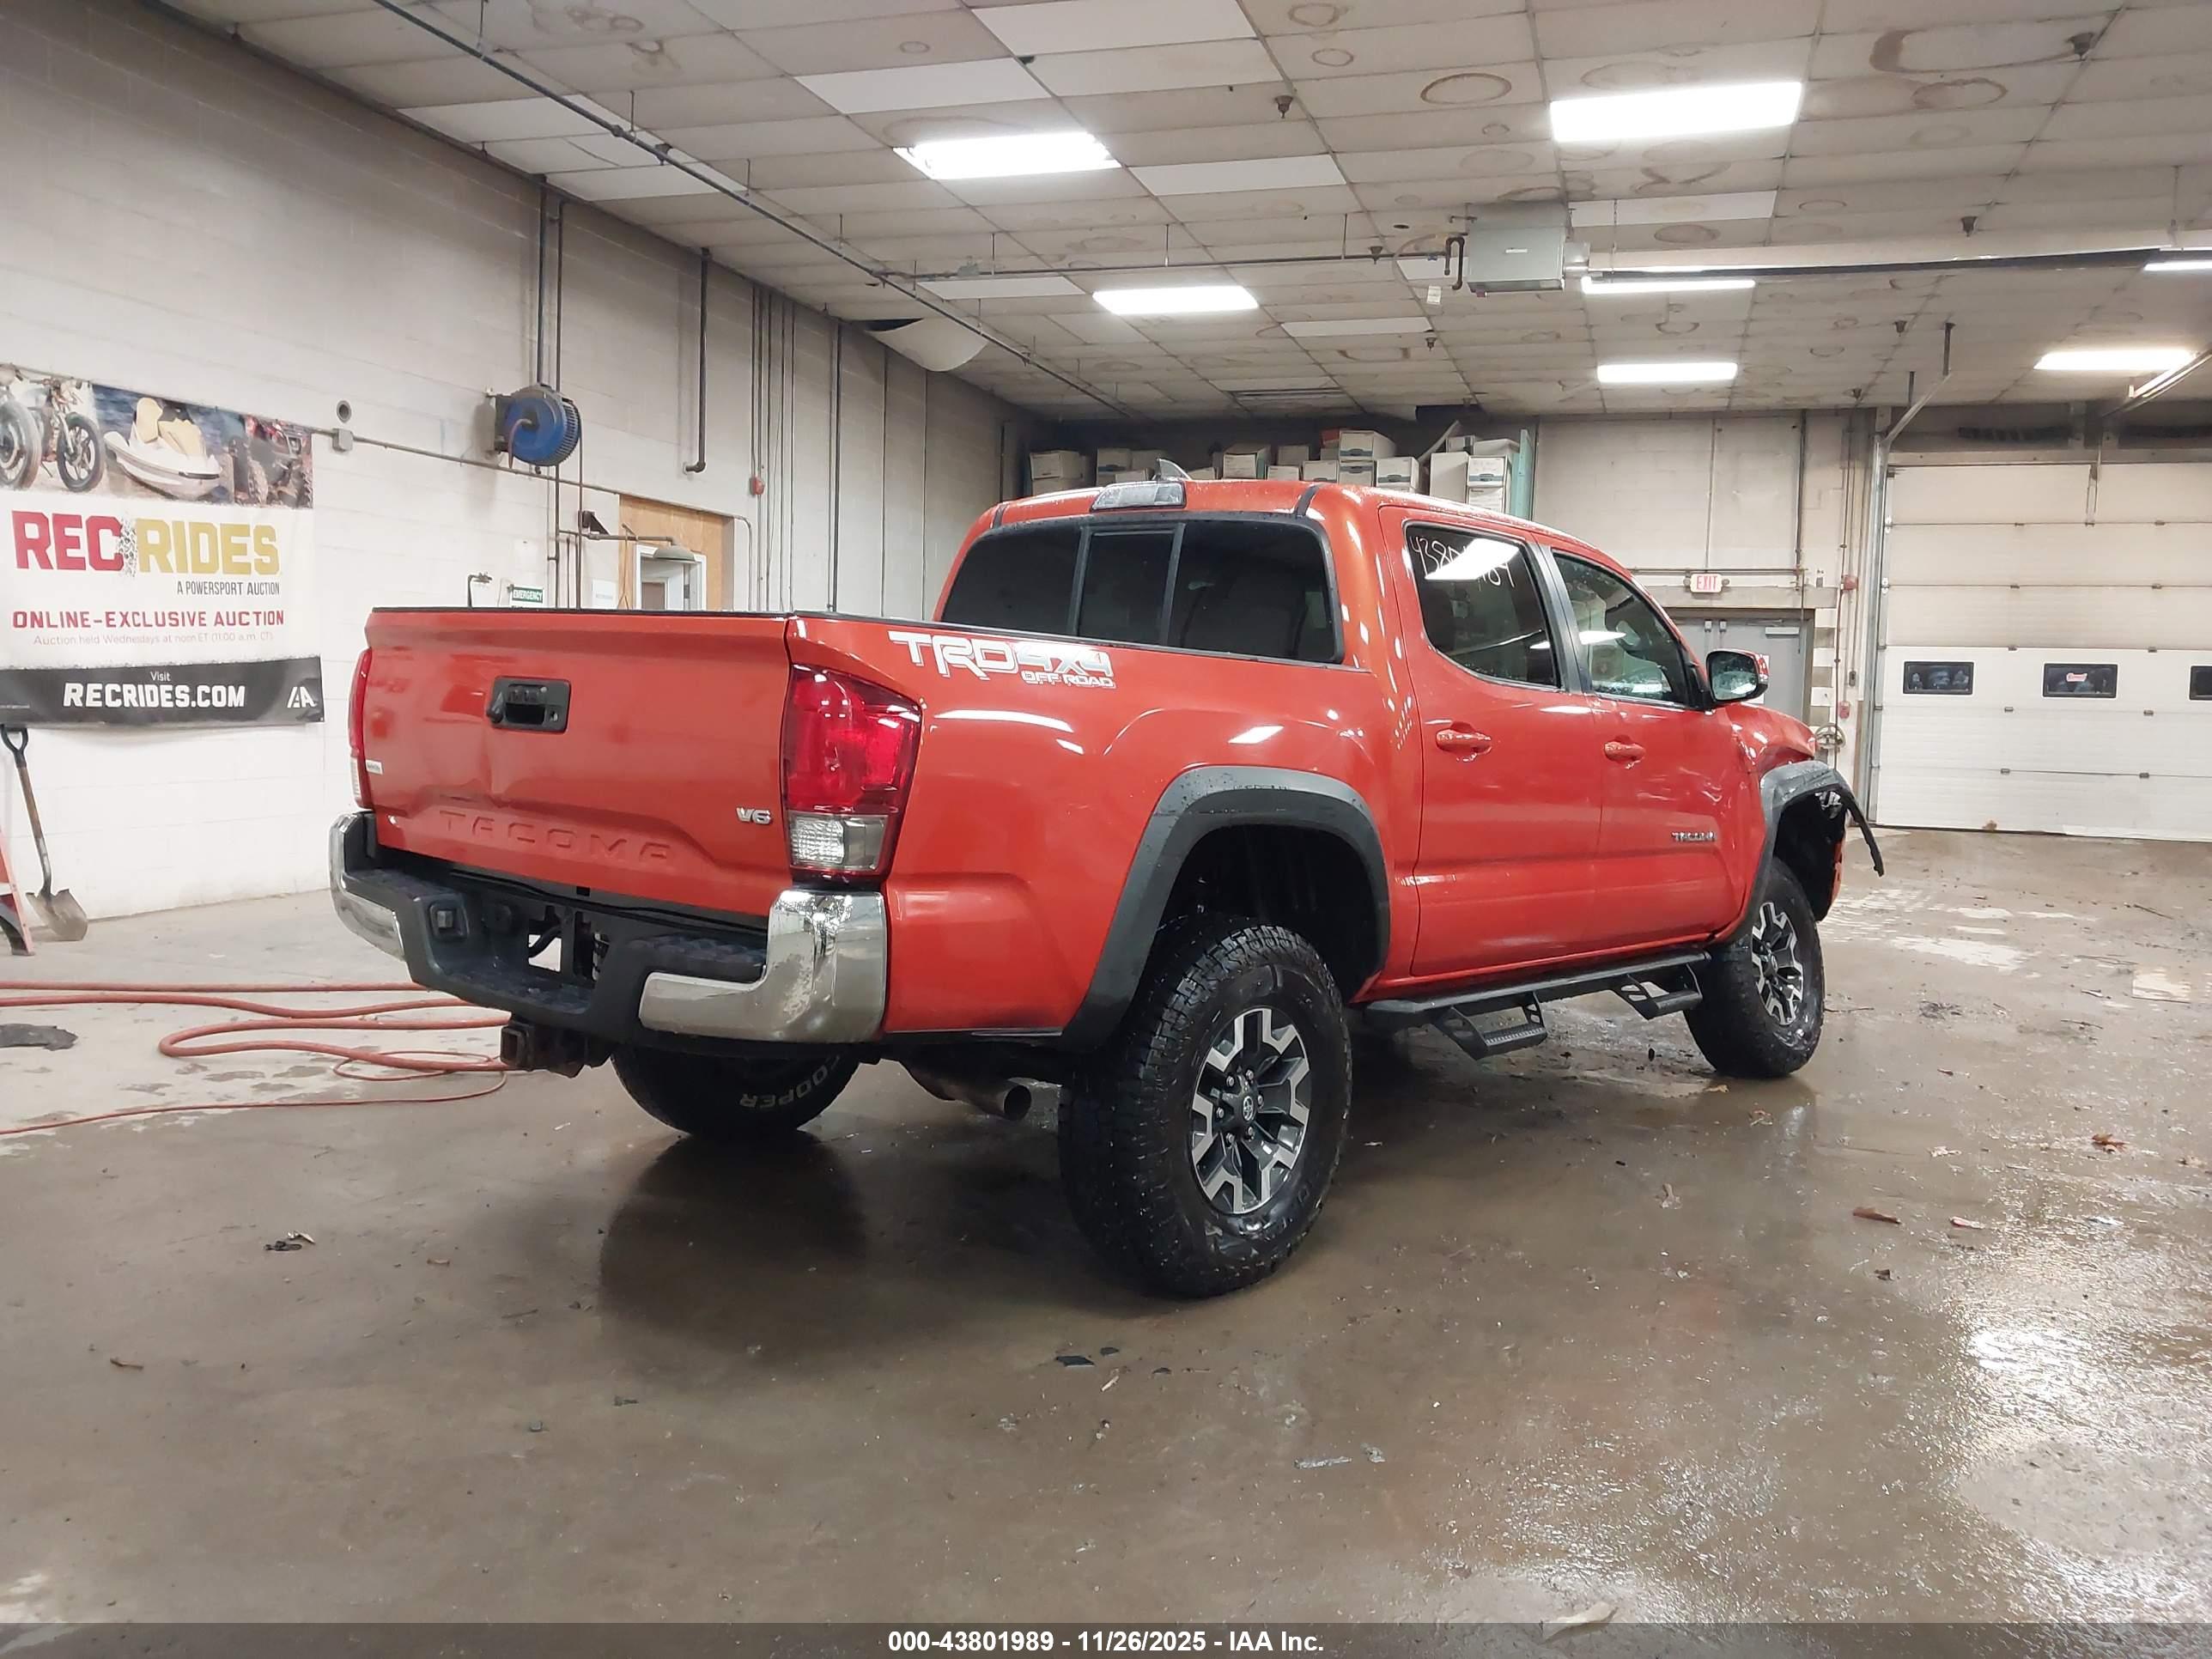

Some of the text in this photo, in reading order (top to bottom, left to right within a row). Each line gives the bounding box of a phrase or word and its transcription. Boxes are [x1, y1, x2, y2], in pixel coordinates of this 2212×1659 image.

[12, 510, 281, 574] REC RIDES
[177, 581, 280, 596] A POWERSPORT AUCTION
[1697, 575, 1718, 591] EXIT
[513, 590, 543, 602] EMERGENCY
[13, 611, 284, 629] ONLINE-EXCLUSIVE AUCTION
[33, 635, 76, 646] Auction
[79, 634, 100, 646] held
[102, 634, 160, 646] Wednesdays
[163, 633, 173, 643] at
[174, 634, 196, 643] noon
[198, 632, 209, 642] ET
[888, 631, 1019, 680] TRD
[149, 671, 172, 683] Visit
[1020, 670, 1116, 689] OFF ROAD
[63, 683, 246, 708] RECRIDES.COM
[736, 807, 771, 824] V6
[439, 810, 674, 863] TACOMA
